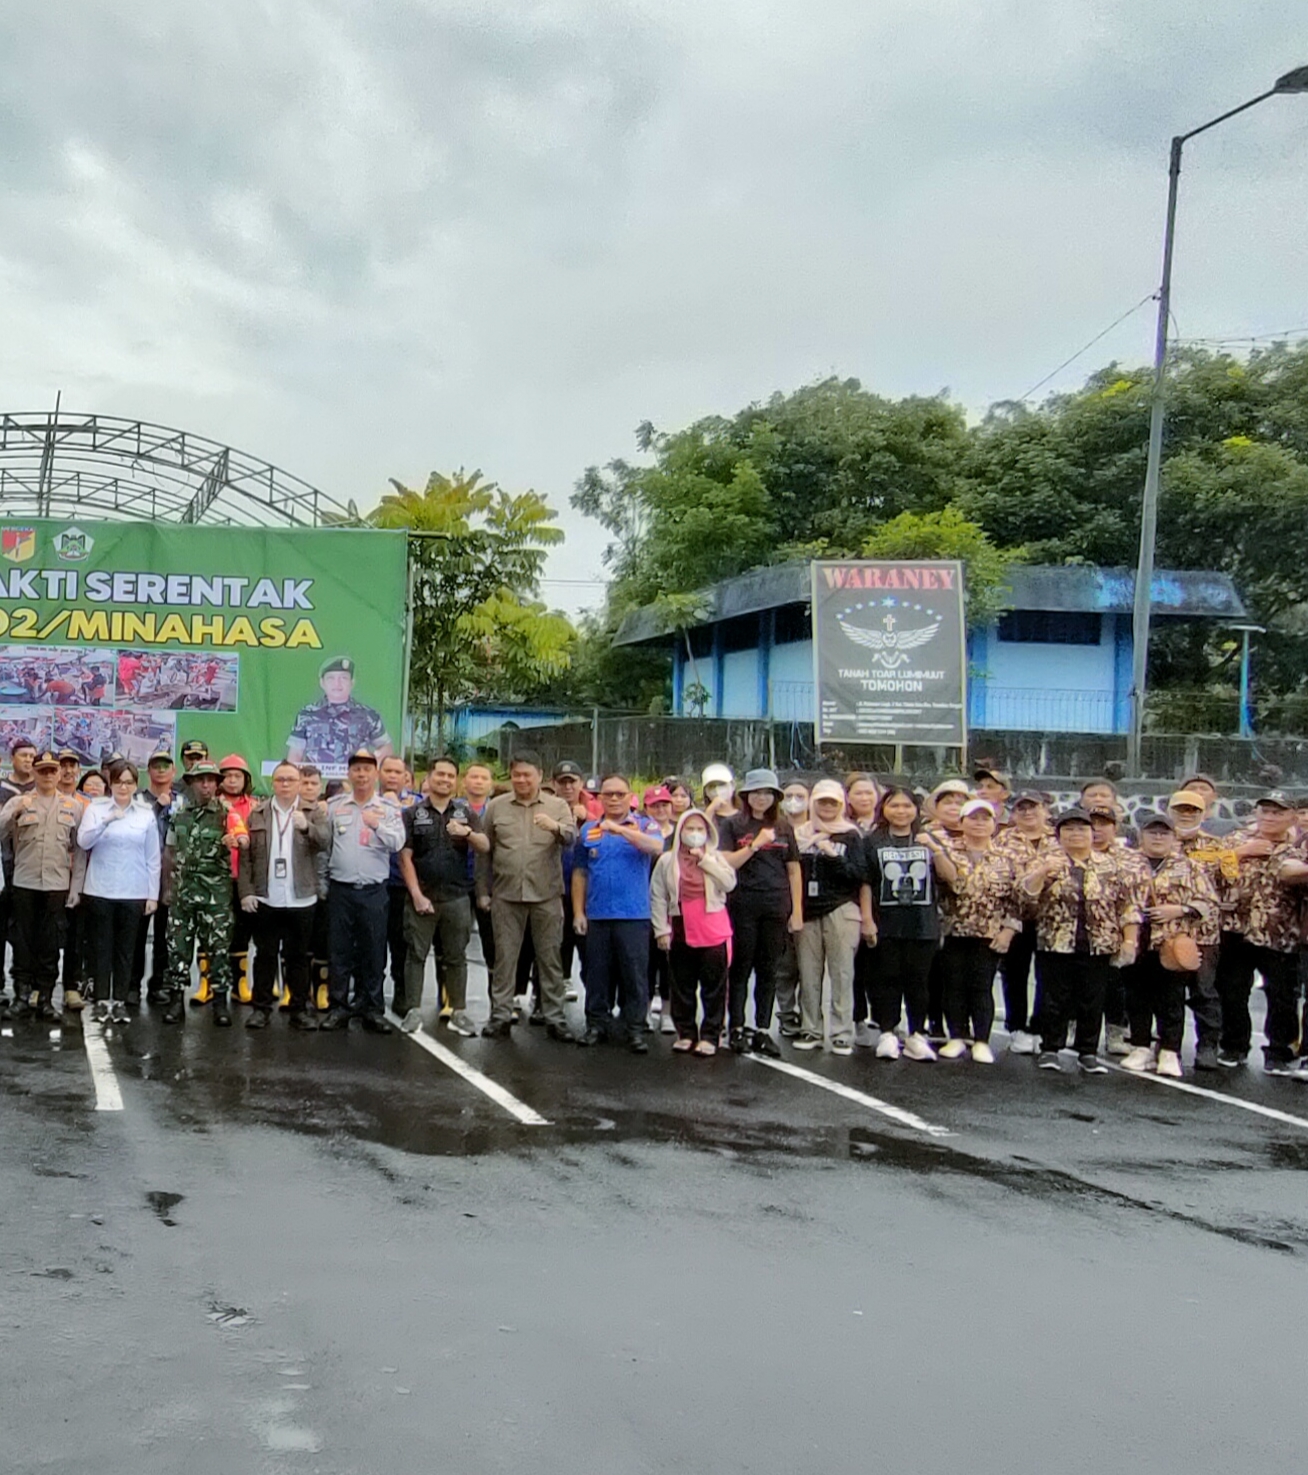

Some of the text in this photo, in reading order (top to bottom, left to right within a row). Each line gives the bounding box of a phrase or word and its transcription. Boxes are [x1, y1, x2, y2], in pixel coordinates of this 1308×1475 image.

[822, 567, 956, 590] WARANEY
[84, 571, 316, 610] SERENTAK
[838, 669, 870, 678] TANAH
[860, 680, 923, 692] TOMOHON
